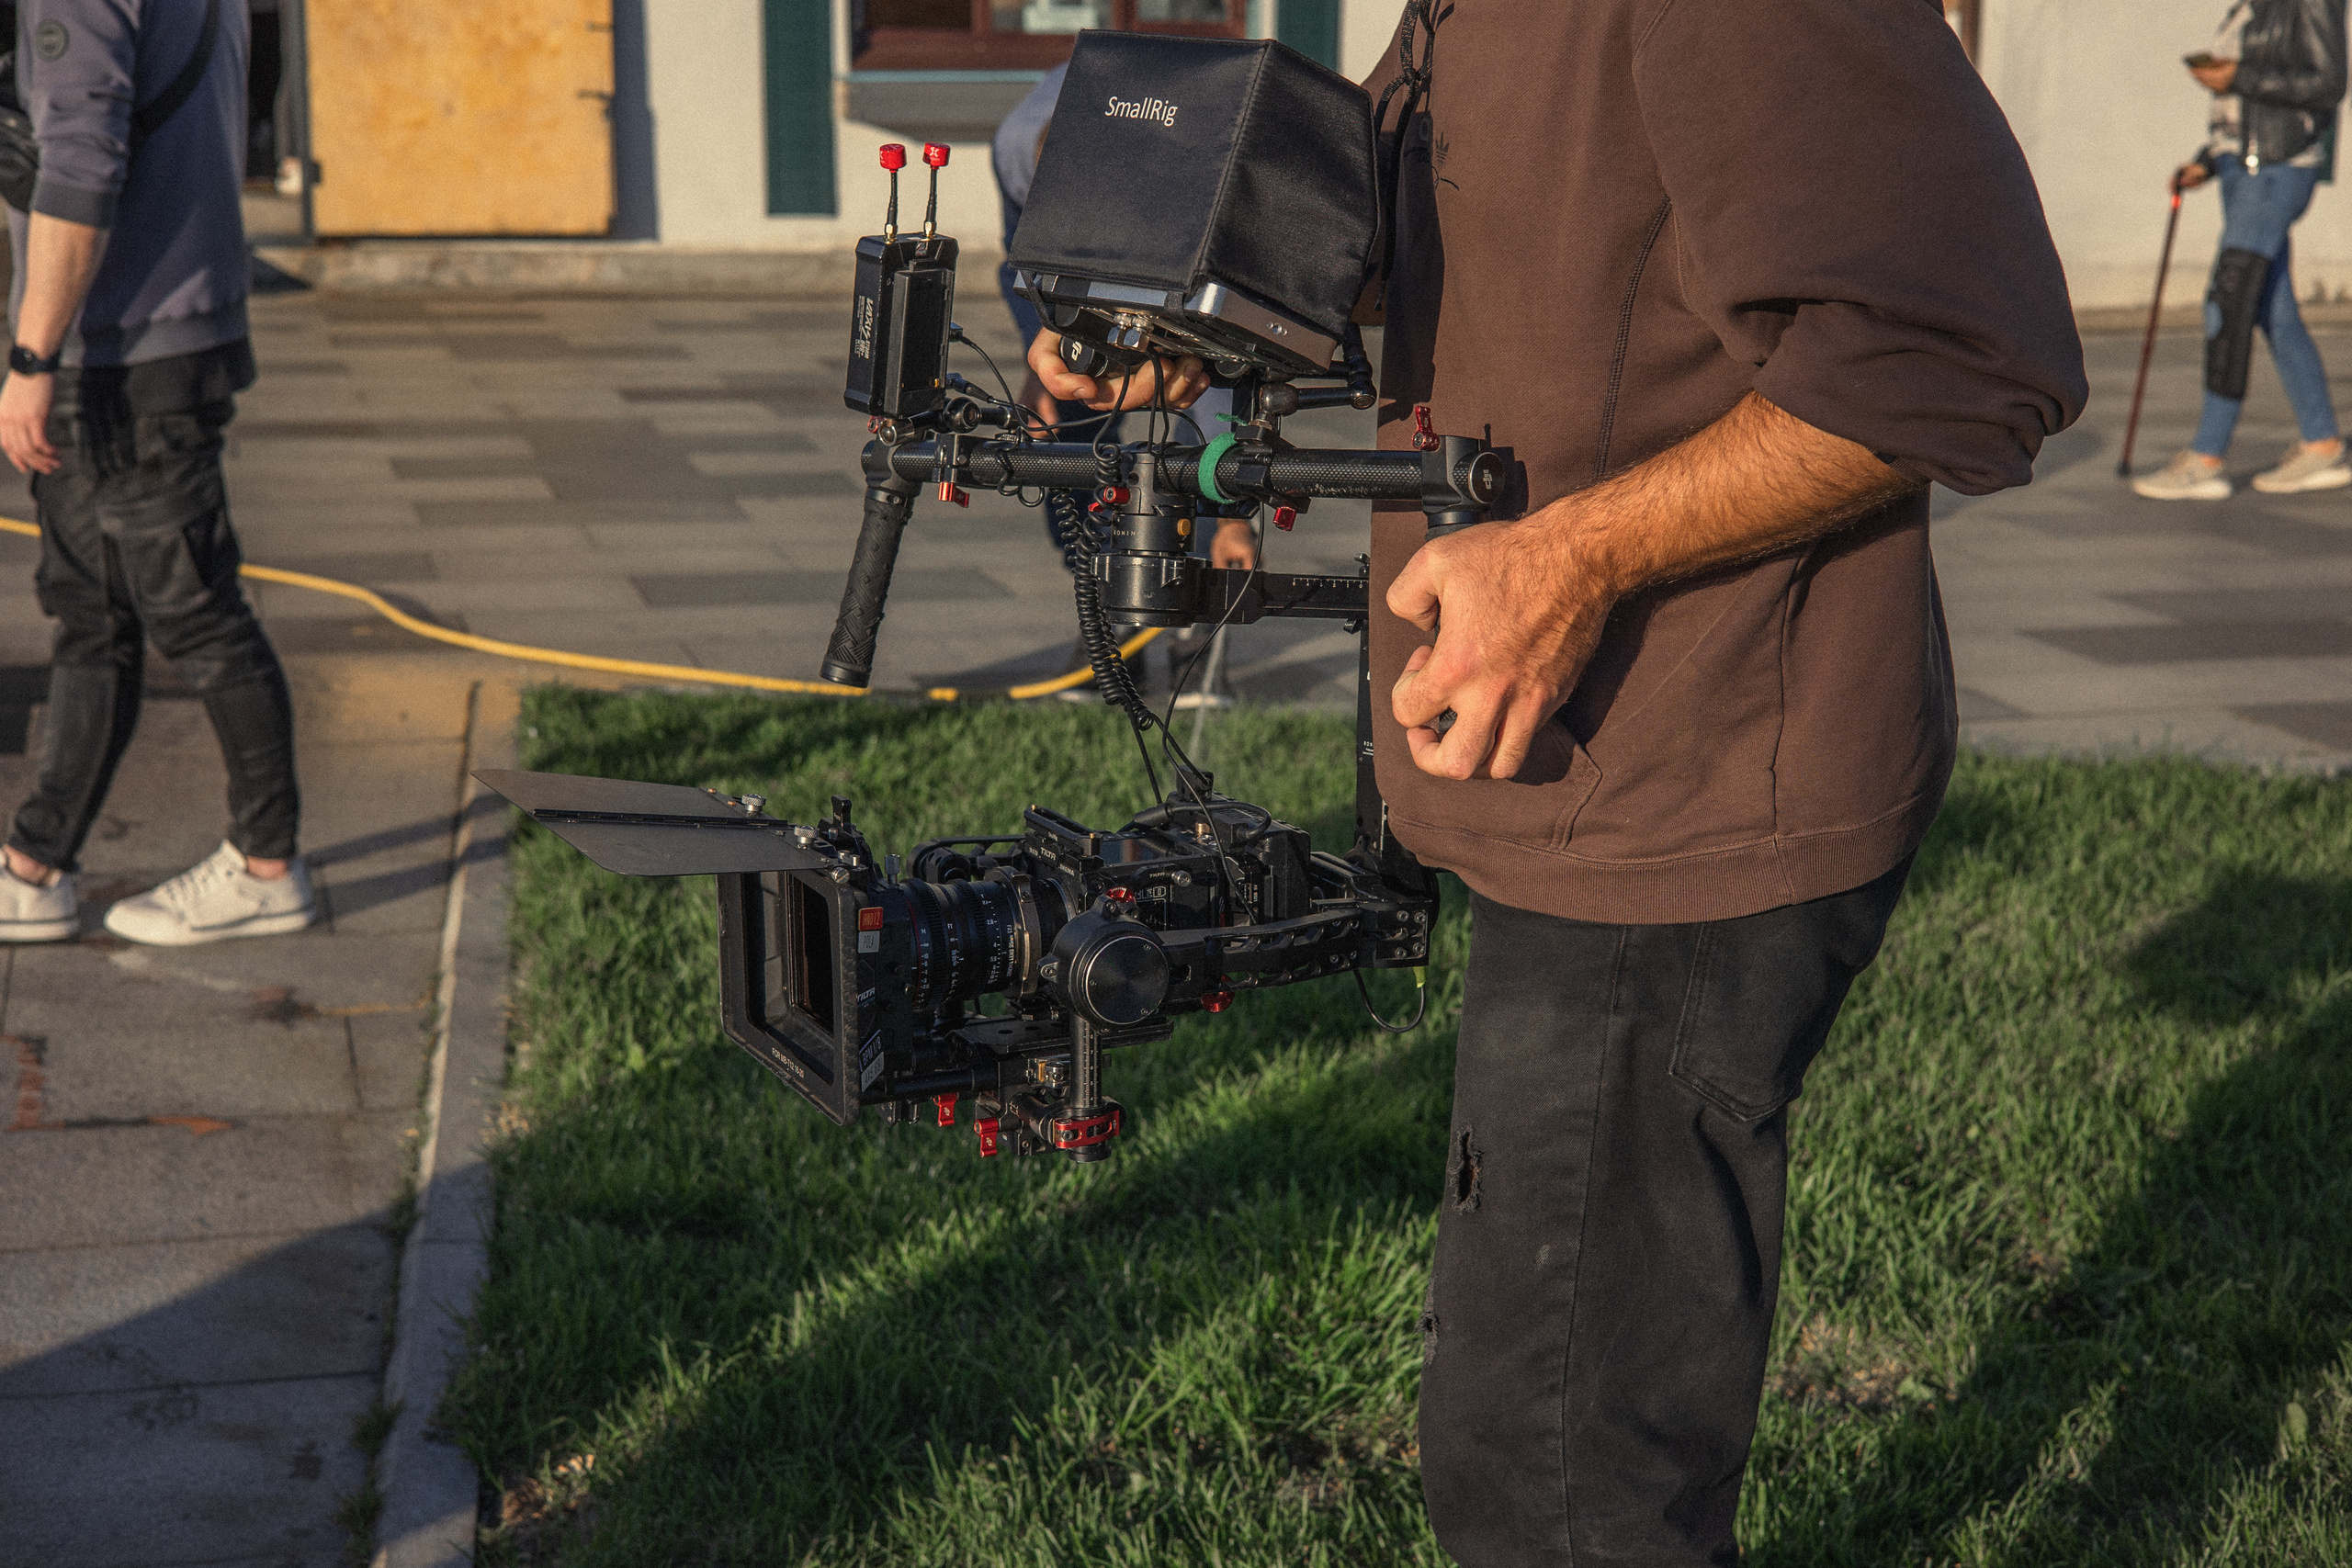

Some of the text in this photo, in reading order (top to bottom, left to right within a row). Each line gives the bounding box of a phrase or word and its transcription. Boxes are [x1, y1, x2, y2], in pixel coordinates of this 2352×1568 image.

[1104, 96, 1179, 128] SmallRig
[862, 297, 873, 339] VAXIS
[1040, 846, 1057, 862] TILTA
[857, 987, 876, 1002] TILTA
